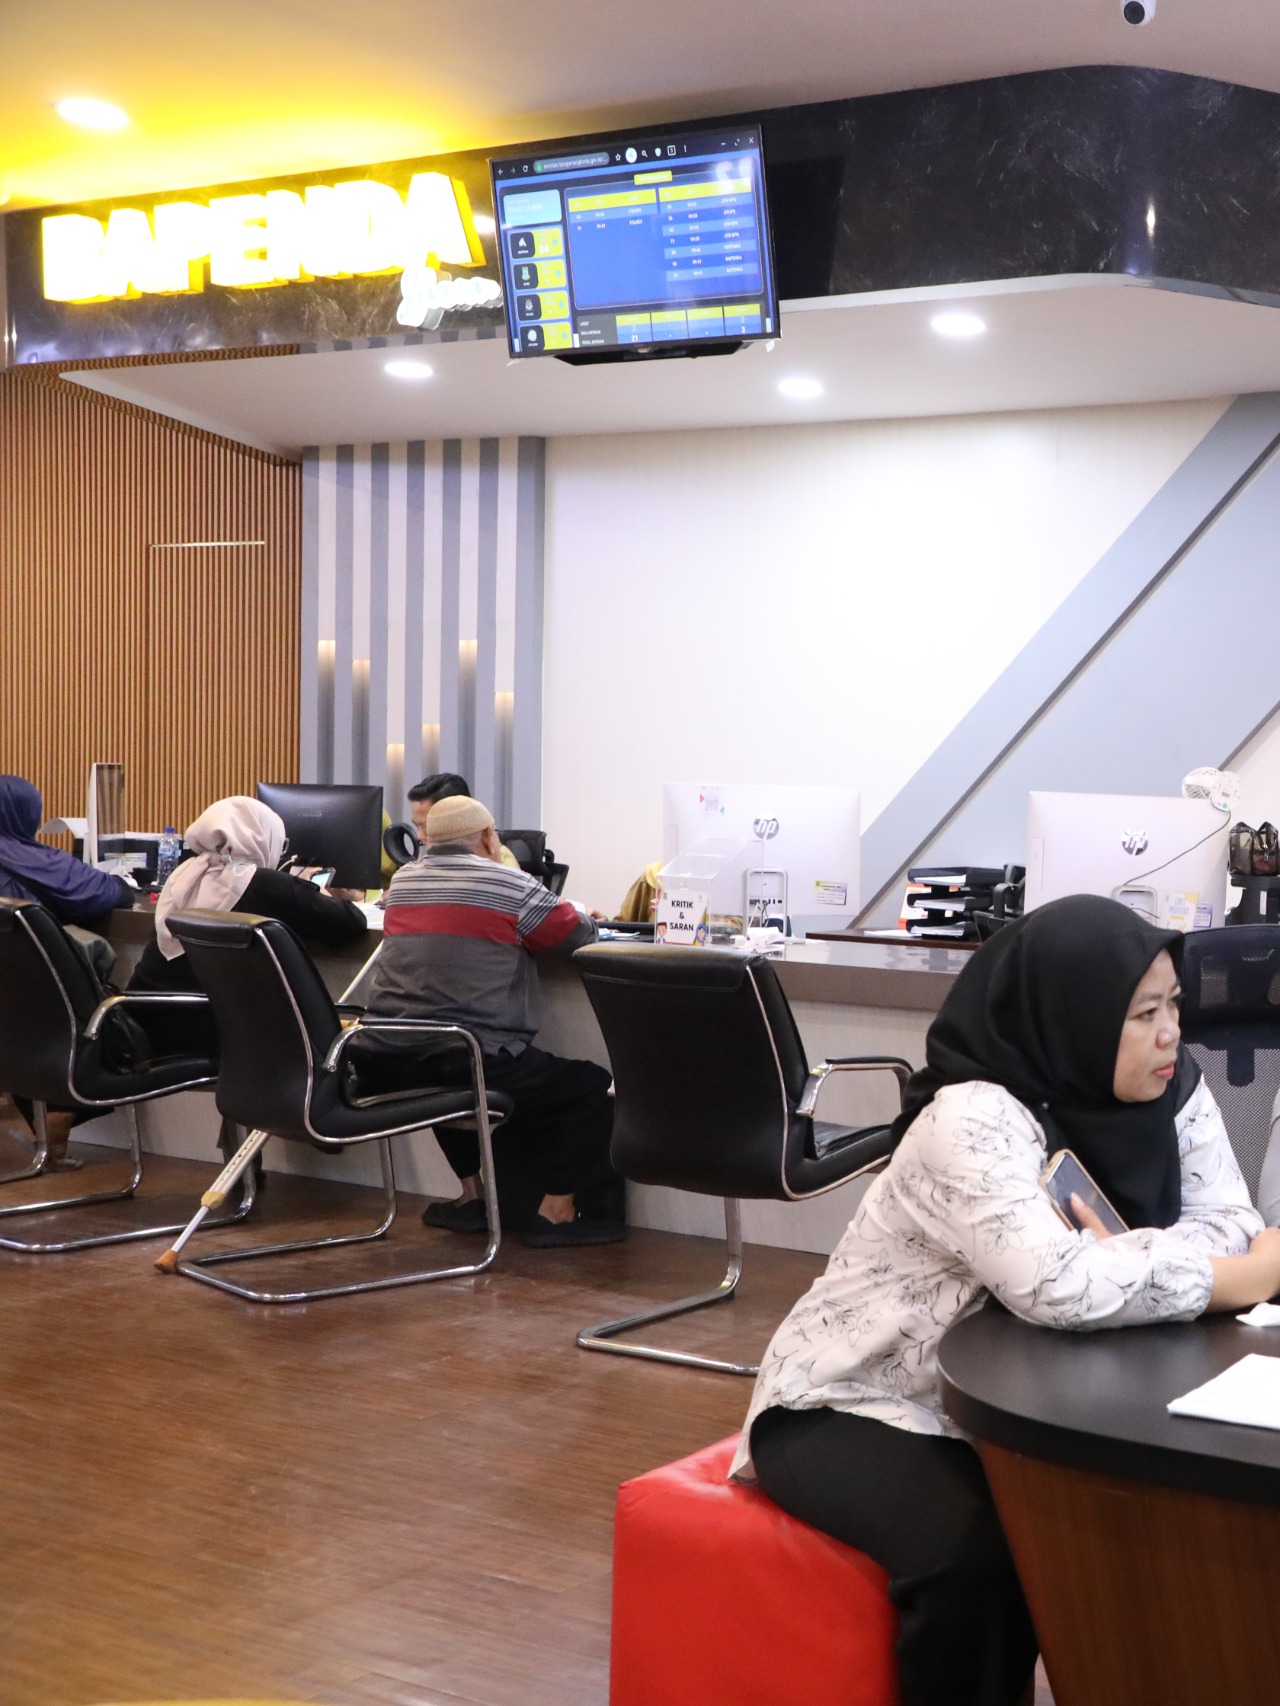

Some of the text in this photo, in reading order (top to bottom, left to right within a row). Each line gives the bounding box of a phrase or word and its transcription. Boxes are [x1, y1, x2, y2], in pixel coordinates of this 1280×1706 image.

[42, 171, 486, 303] BAPENDA
[753, 814, 779, 841] hp
[671, 900, 694, 909] KRITIK
[679, 911, 685, 920] &
[670, 922, 694, 932] SARAN
